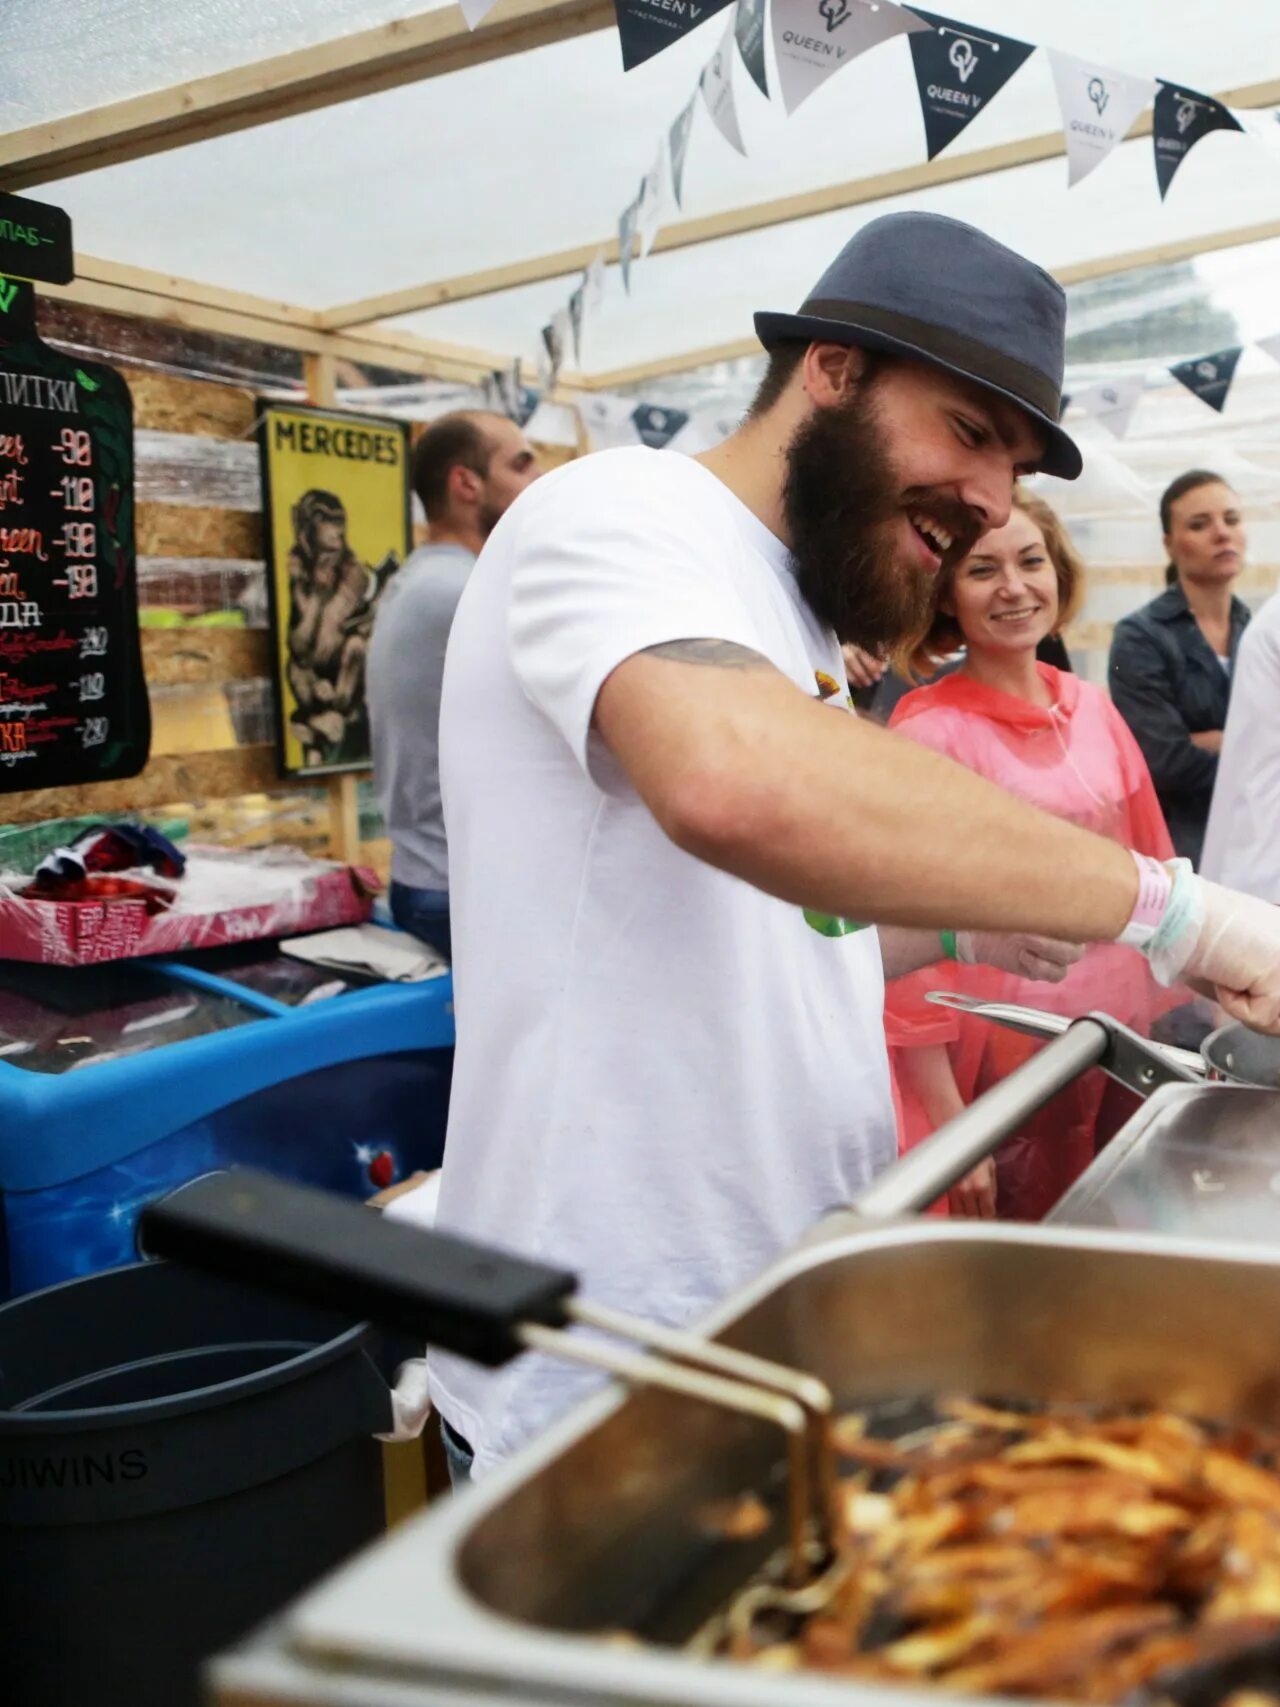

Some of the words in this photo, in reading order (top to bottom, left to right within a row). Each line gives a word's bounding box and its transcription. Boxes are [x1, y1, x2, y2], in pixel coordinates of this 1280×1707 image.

[690, 3, 702, 19] V
[782, 30, 833, 55] QUEEN
[836, 46, 846, 59] V
[927, 84, 971, 105] QUEEN
[972, 94, 981, 108] V
[1070, 120, 1106, 139] QUEEN
[275, 420, 398, 466] MERCEDES
